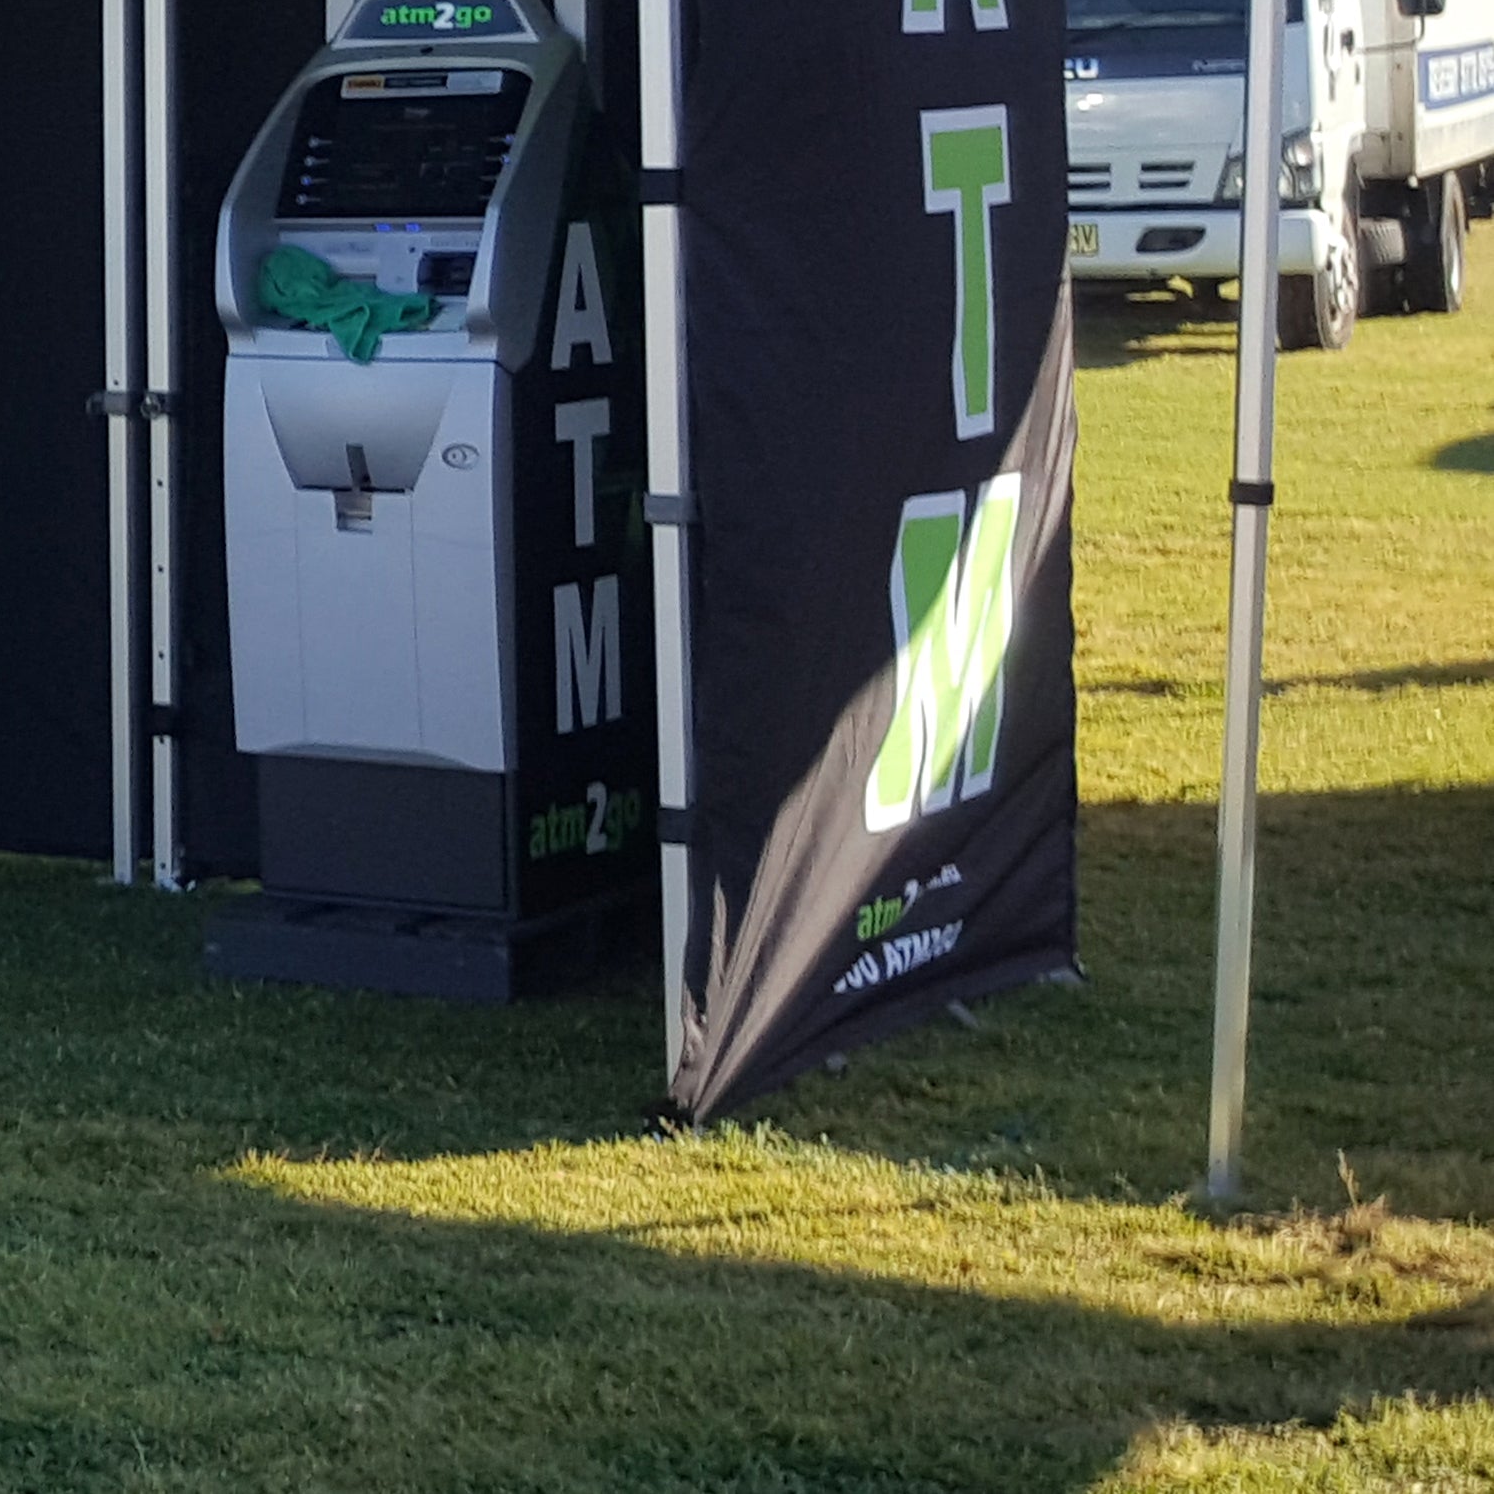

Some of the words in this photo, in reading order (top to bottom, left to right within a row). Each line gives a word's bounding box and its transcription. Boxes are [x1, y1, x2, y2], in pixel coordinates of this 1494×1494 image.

[381, 1, 492, 30] atm2go
[548, 222, 622, 734] ATM
[530, 782, 640, 860] atm2go
